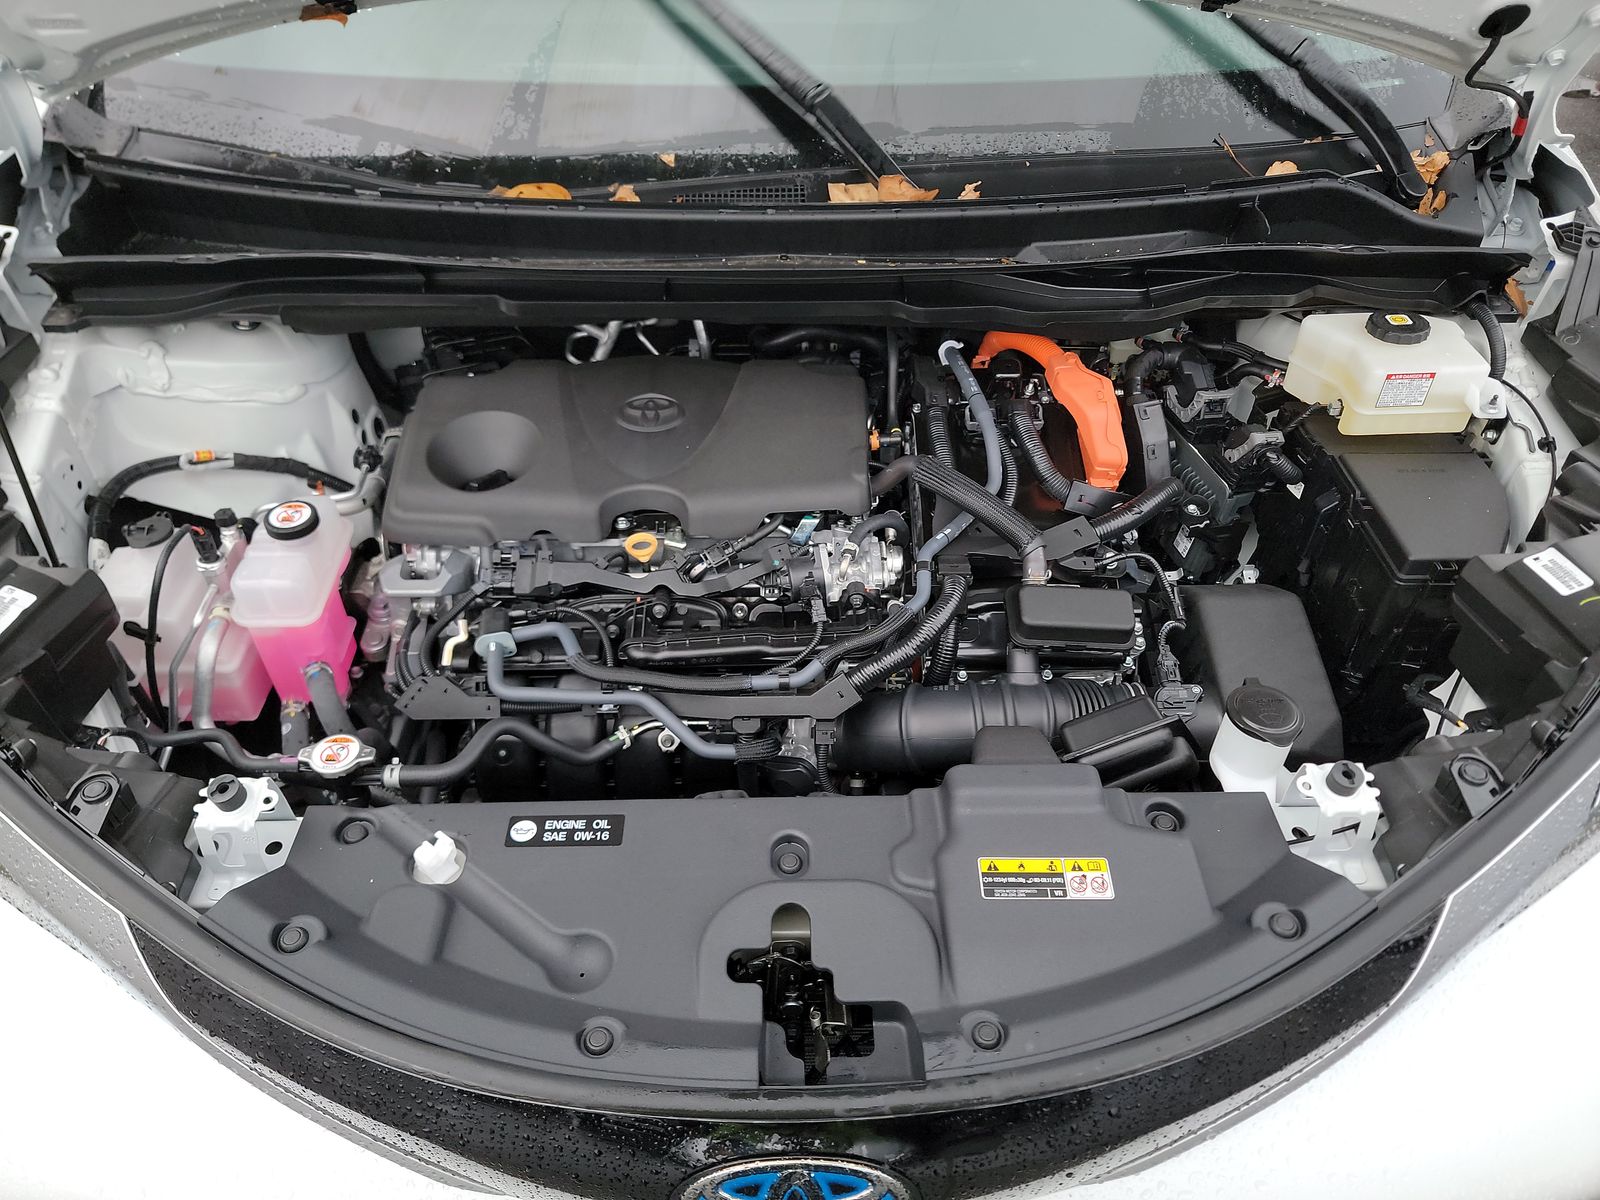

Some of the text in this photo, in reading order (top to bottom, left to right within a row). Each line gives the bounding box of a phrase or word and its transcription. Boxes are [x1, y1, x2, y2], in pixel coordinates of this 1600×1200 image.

[544, 819, 611, 830] ENGINE OIL
[542, 831, 610, 842] SAE 0W-16
